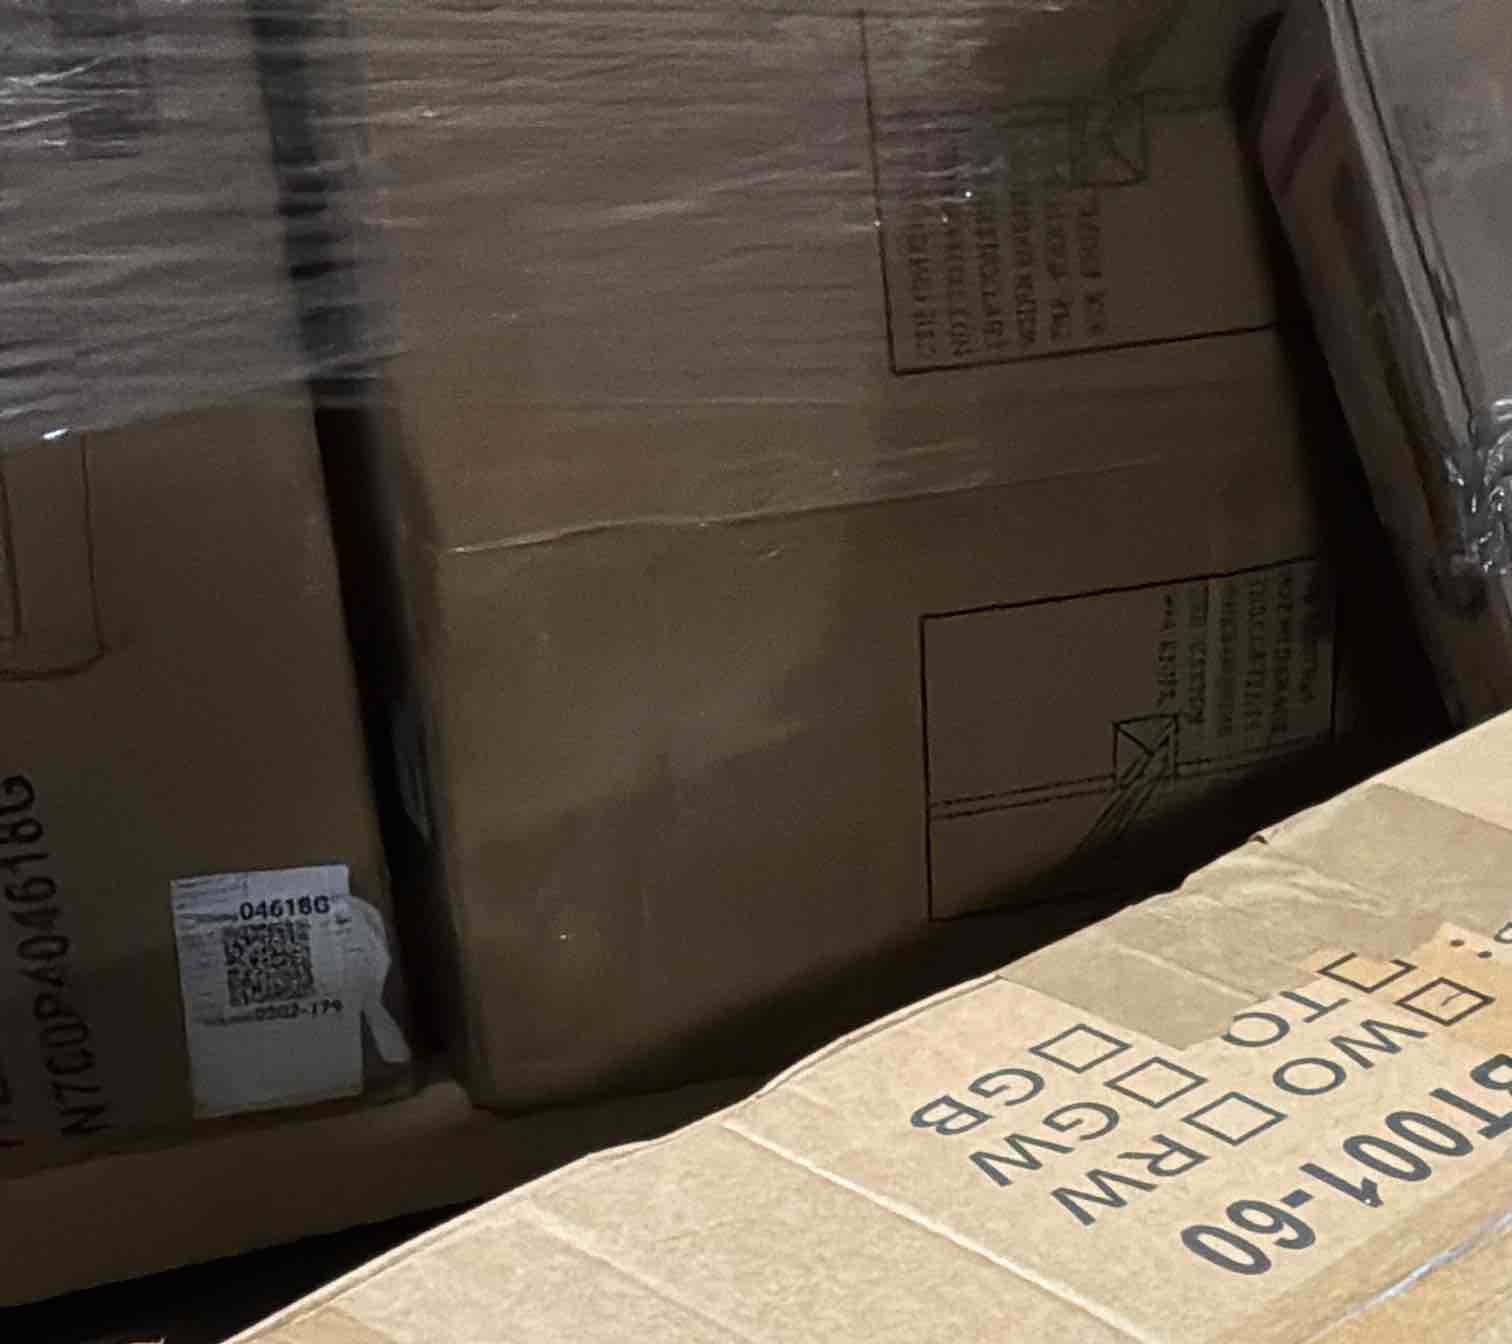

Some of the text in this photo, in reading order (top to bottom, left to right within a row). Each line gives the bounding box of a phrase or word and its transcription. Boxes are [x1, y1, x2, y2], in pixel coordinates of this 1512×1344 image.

[1272, 1018, 1429, 1095] WO
[910, 1067, 1046, 1138] GB
[967, 1101, 1121, 1187] GW
[1051, 1133, 1210, 1228] RW
